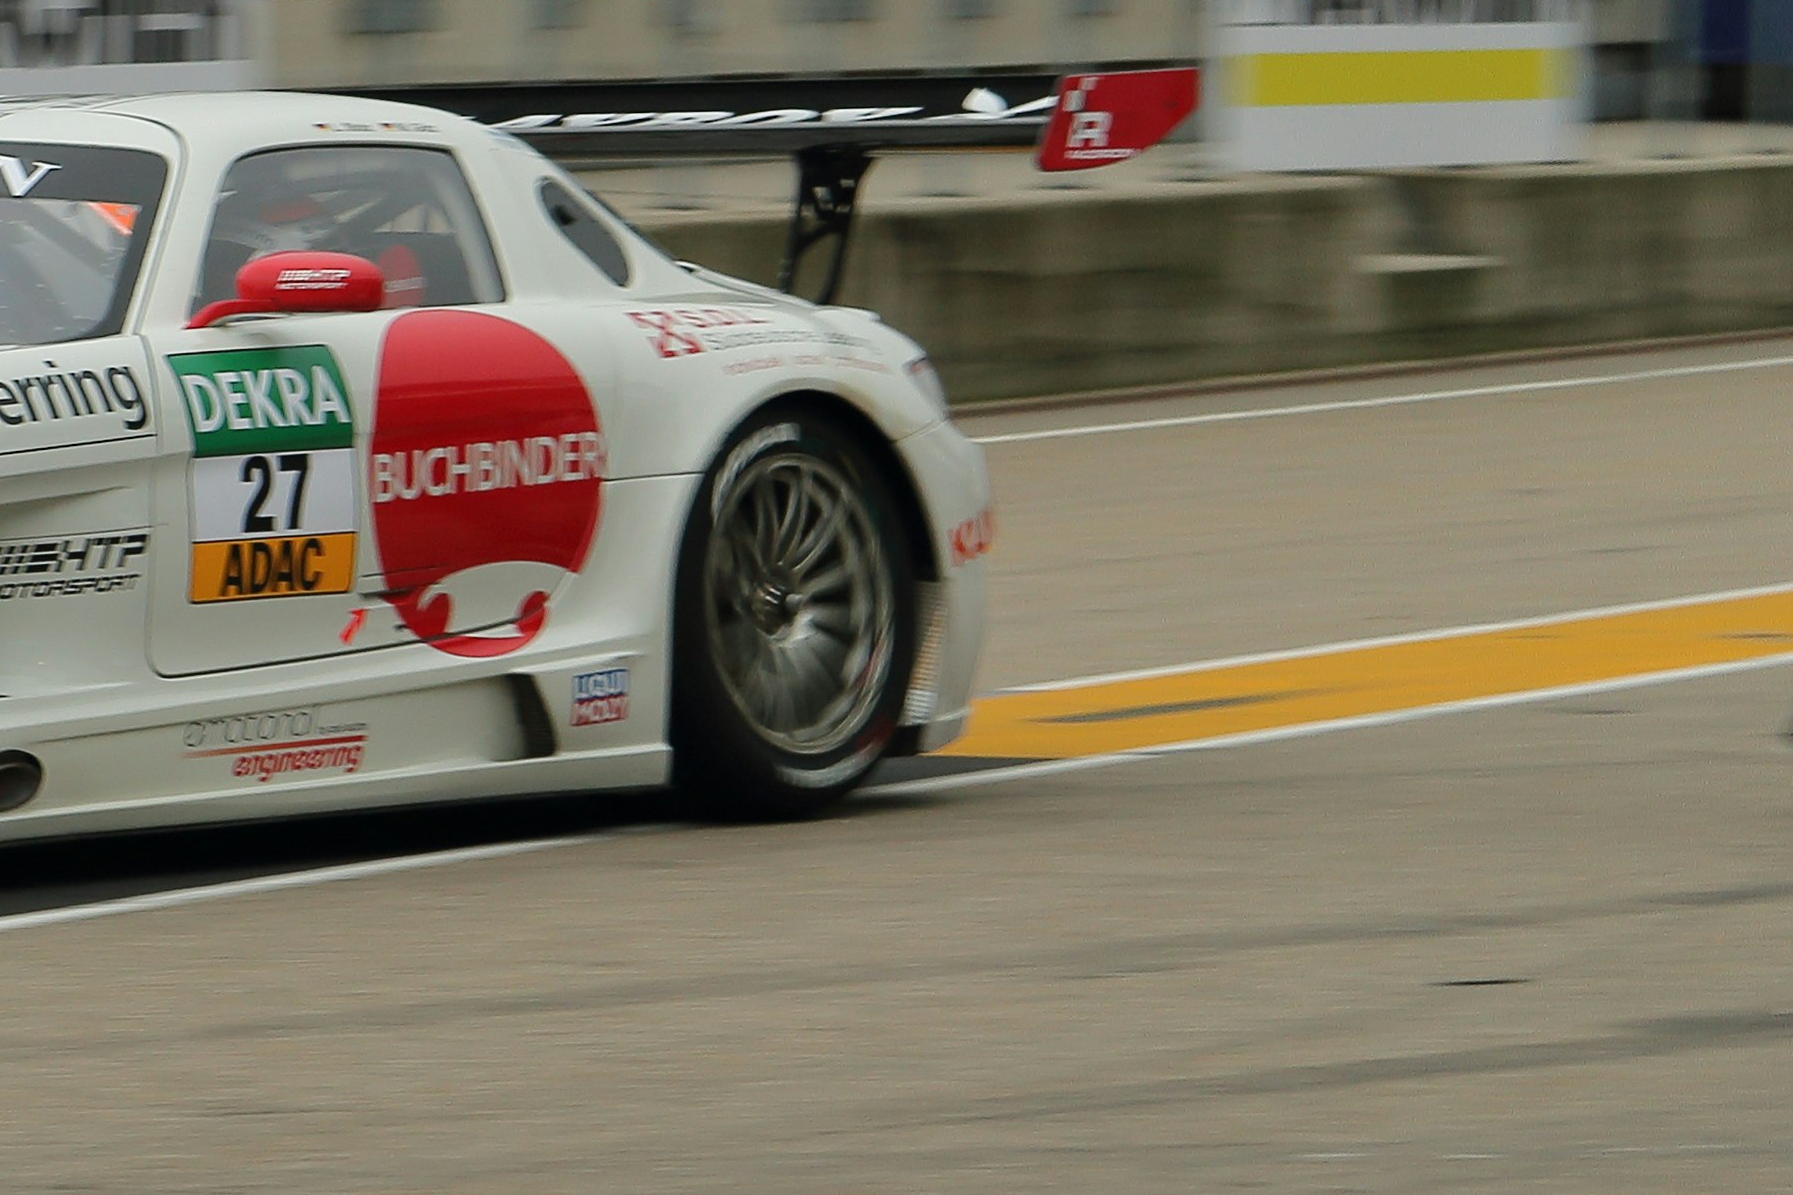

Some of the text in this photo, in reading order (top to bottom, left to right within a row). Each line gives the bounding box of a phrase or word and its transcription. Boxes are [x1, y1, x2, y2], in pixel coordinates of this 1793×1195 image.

[181, 365, 351, 434] DEKRA
[240, 454, 313, 534] 27
[371, 431, 607, 503] BUCHBINDER
[219, 539, 326, 597] ADAC
[232, 745, 364, 783] engineering
